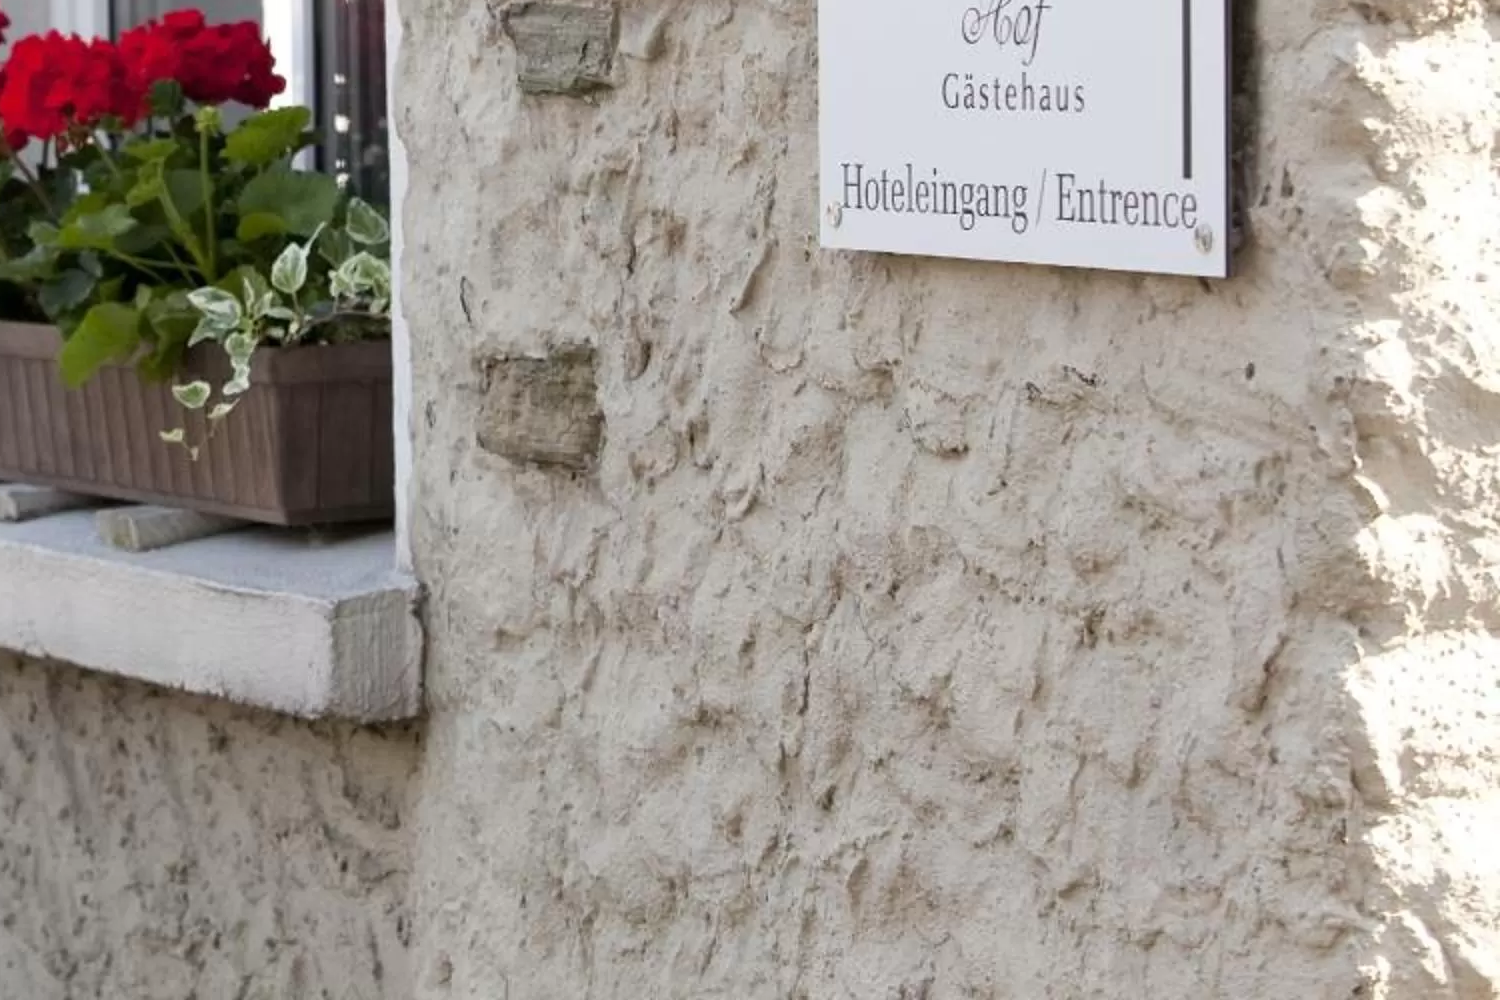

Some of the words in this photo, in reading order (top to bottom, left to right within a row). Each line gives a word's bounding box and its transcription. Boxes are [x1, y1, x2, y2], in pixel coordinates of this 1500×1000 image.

[941, 72, 1085, 112] Gästehaus
[841, 163, 1028, 235] Hoteleingang
[1055, 172, 1198, 230] Entrence
